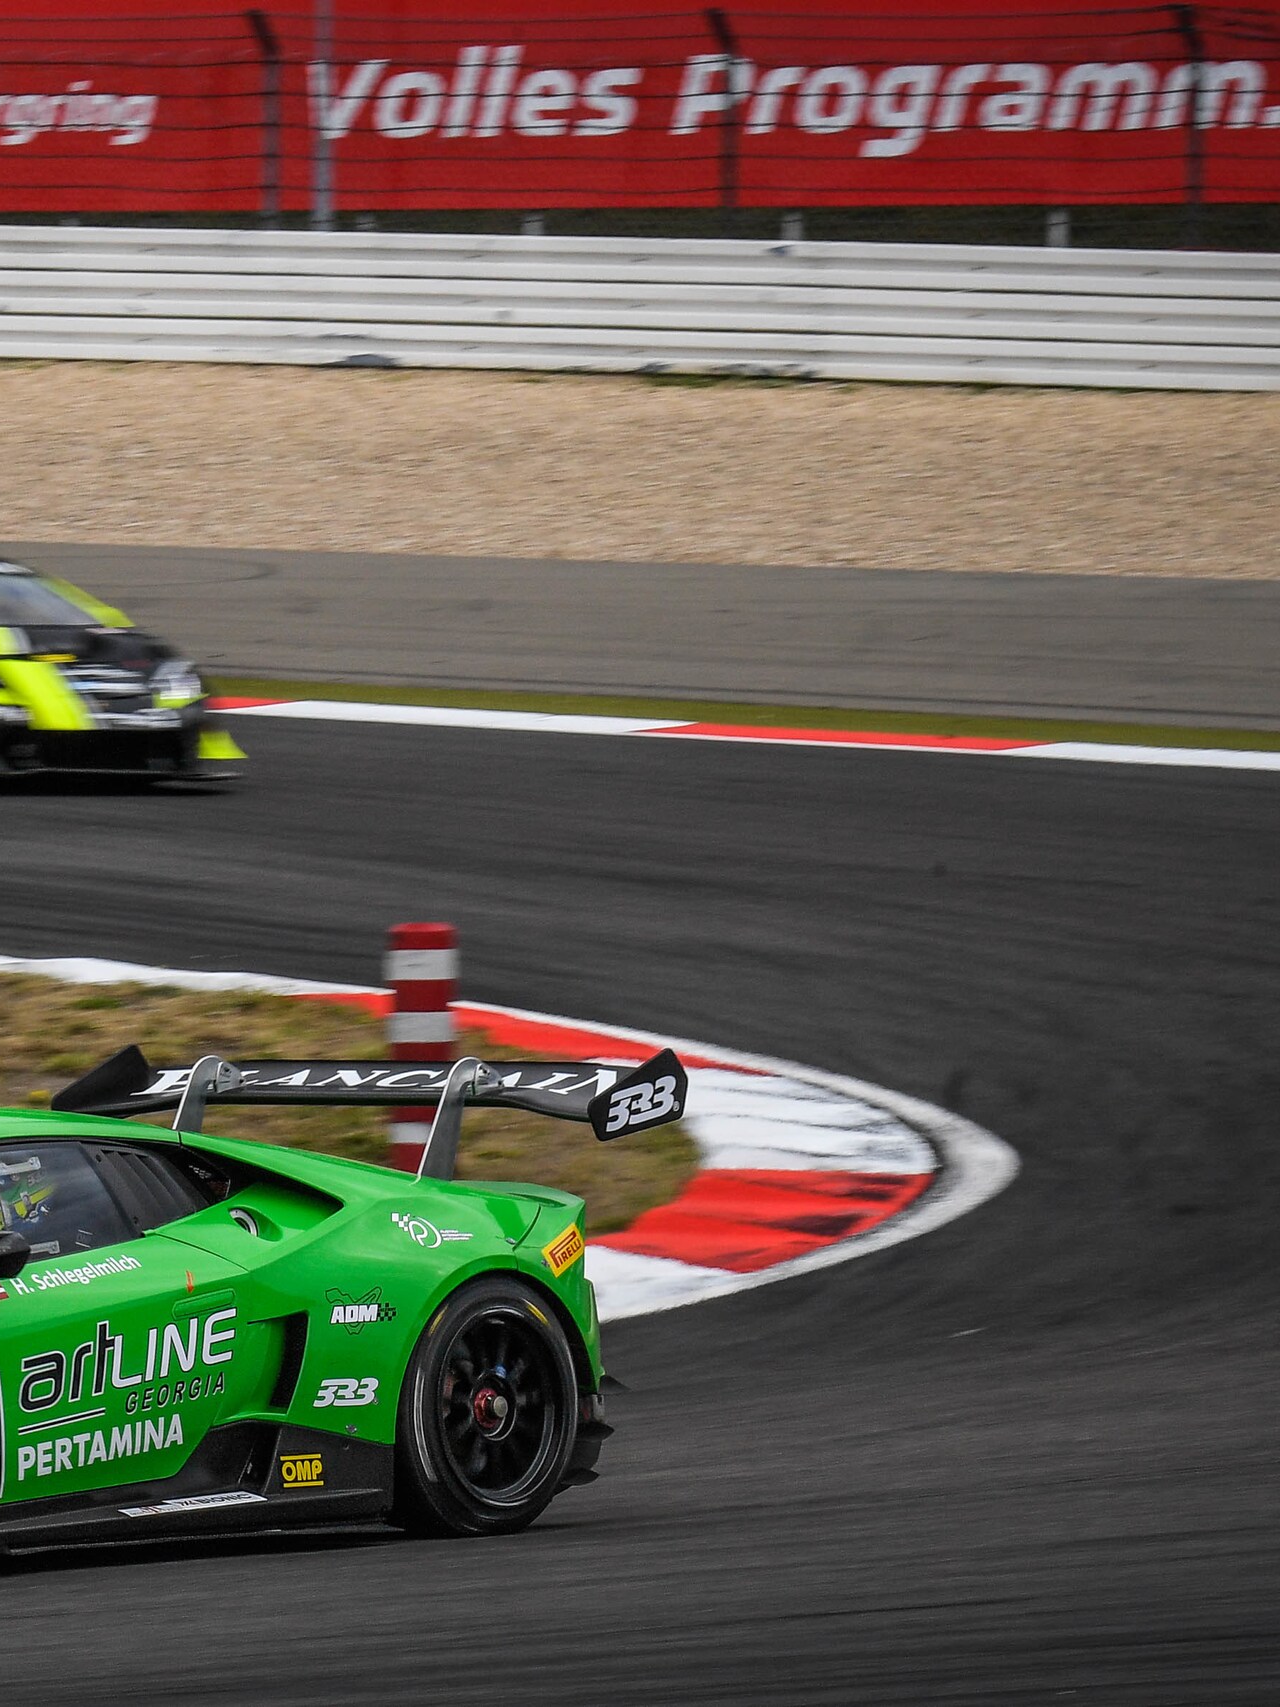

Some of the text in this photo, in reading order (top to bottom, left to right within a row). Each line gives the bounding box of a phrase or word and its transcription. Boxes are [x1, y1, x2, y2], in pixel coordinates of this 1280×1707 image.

[306, 45, 1280, 157] Volles Programm.
[130, 1067, 617, 1097] BANCIN
[549, 1230, 582, 1268] PIRELLI
[10, 1254, 142, 1295] H. Schlegelmilch
[330, 1304, 379, 1324] ADM
[125, 1372, 225, 1415] GEORGIA
[18, 1413, 183, 1481] PERTAMINA
[281, 1459, 323, 1482] OMP
